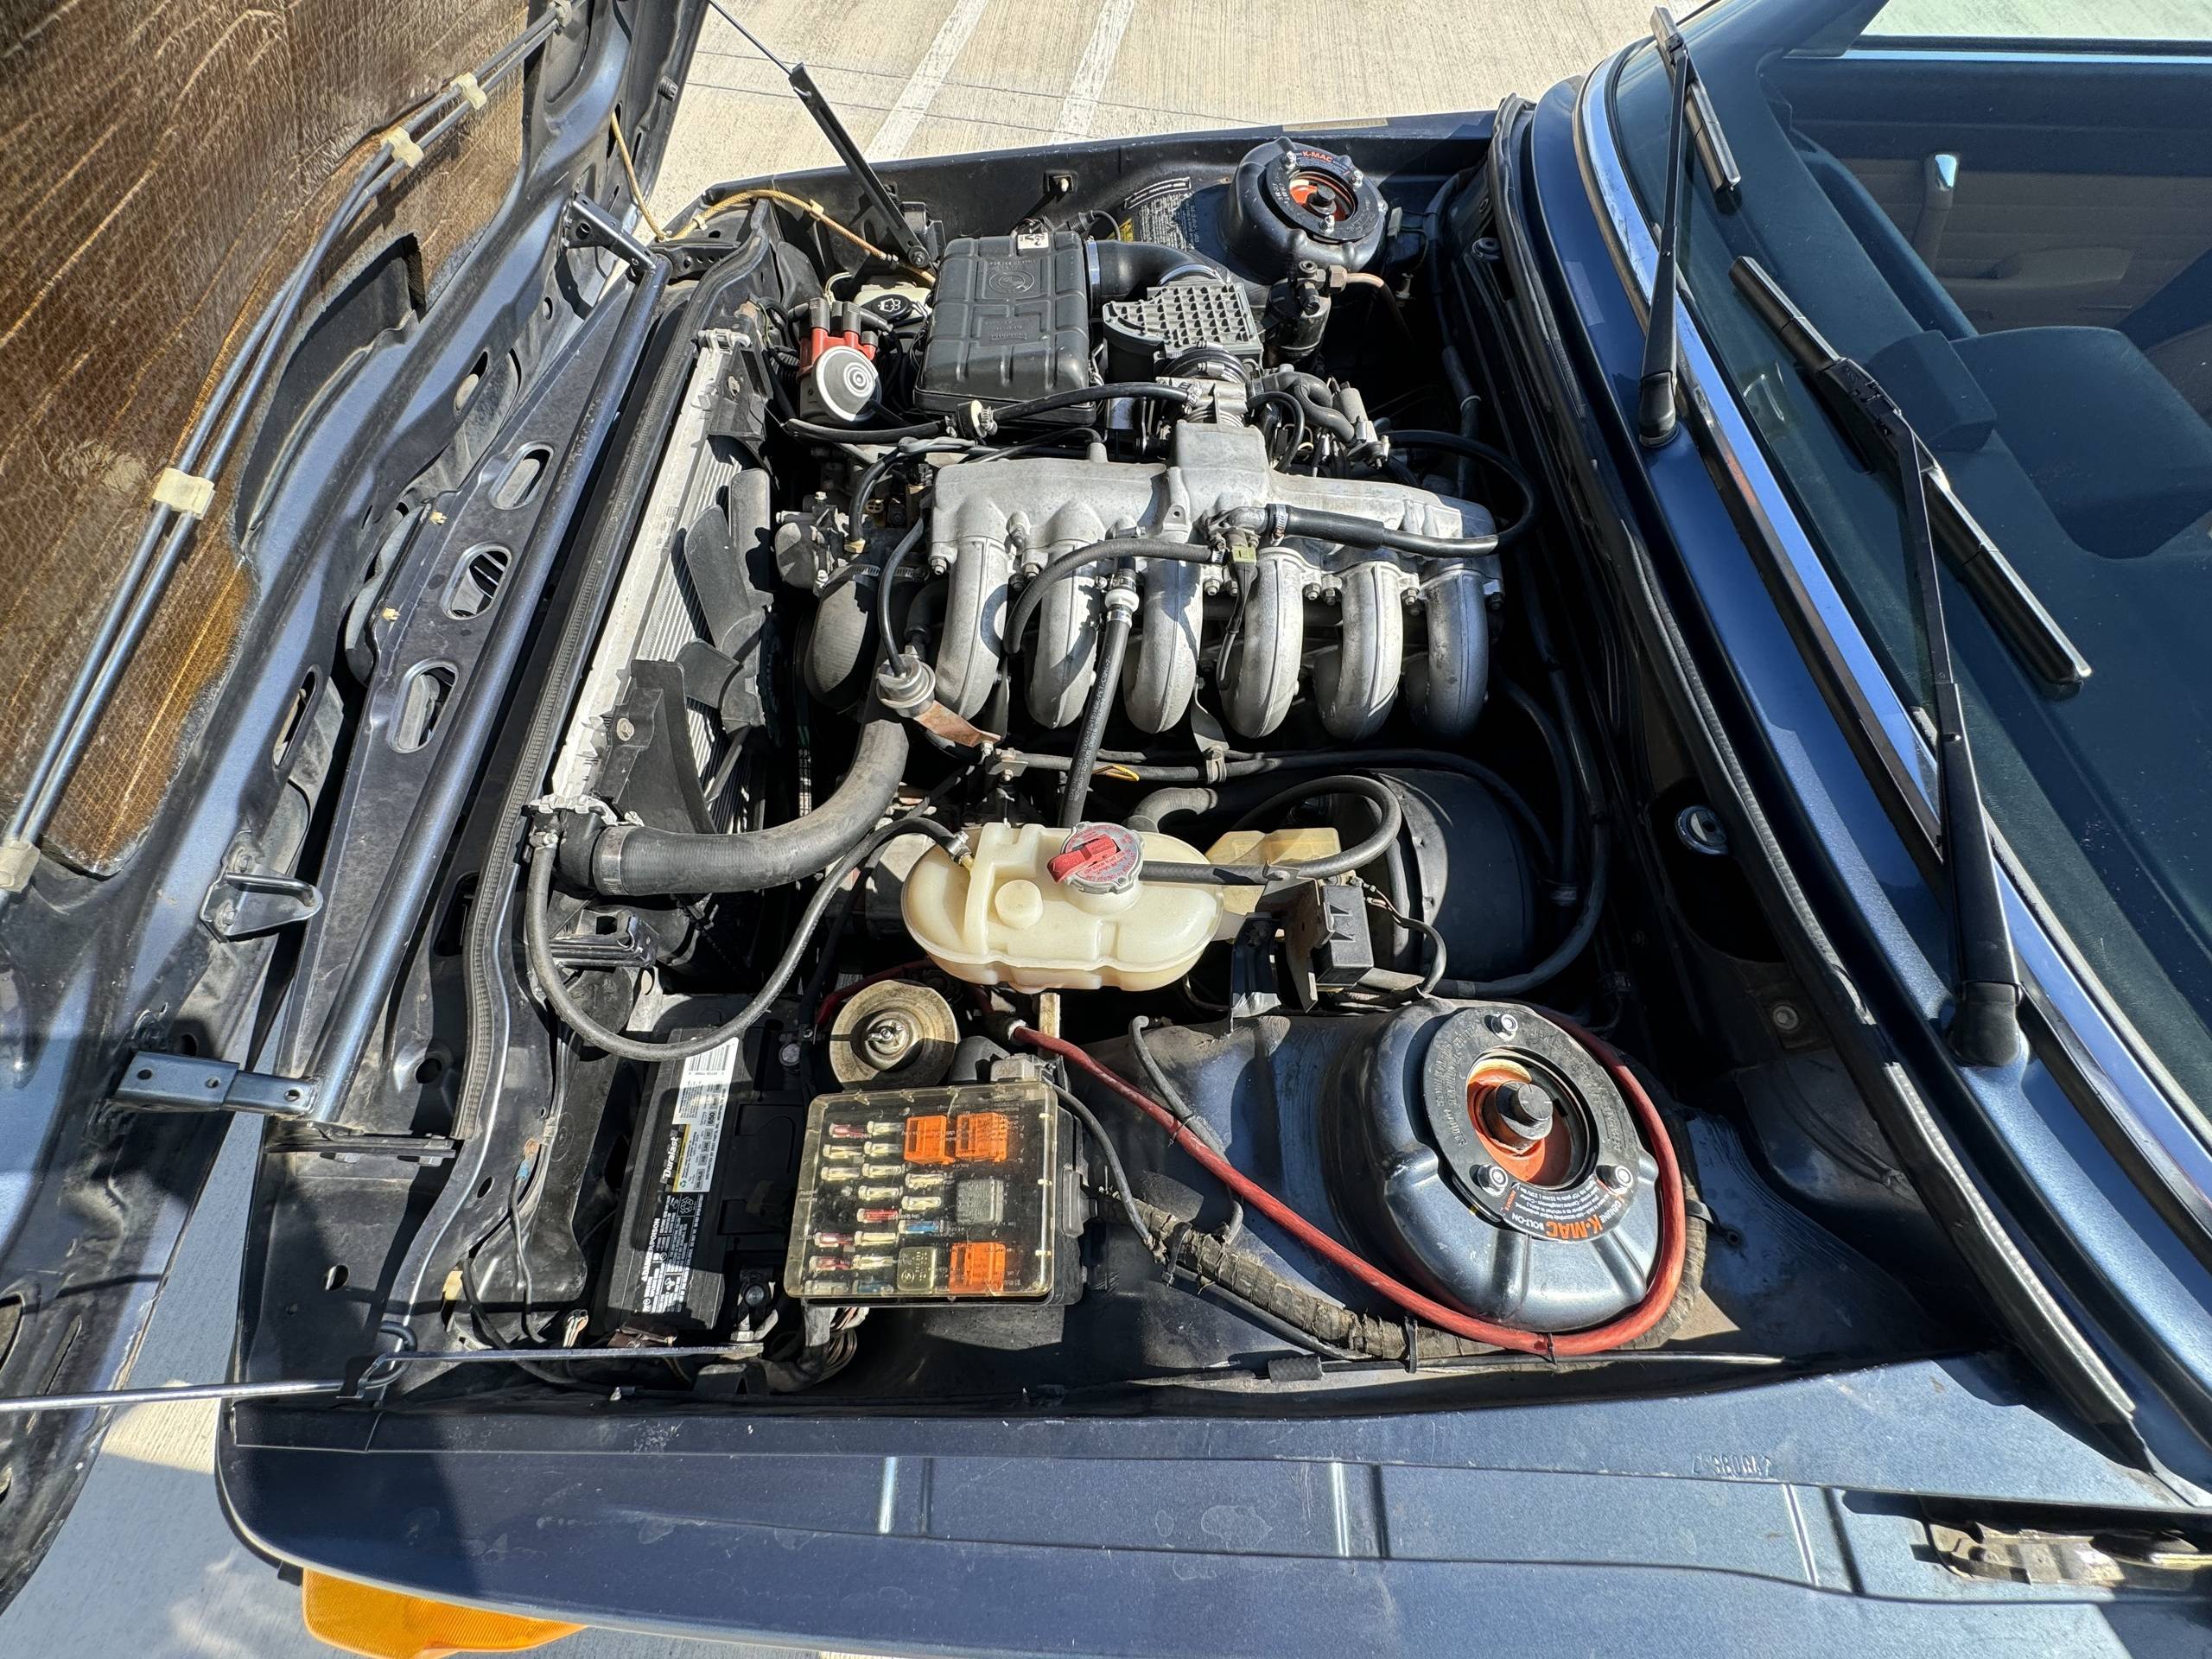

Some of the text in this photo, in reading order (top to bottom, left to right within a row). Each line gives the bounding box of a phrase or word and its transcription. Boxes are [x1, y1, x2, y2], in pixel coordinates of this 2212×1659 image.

[1302, 151, 1333, 162] K-MAC
[707, 1111, 715, 1124] 650
[662, 1136, 679, 1179] Duralast
[1512, 1212, 1544, 1231] BOLT-ON
[1599, 1200, 1622, 1224] GENUINE
